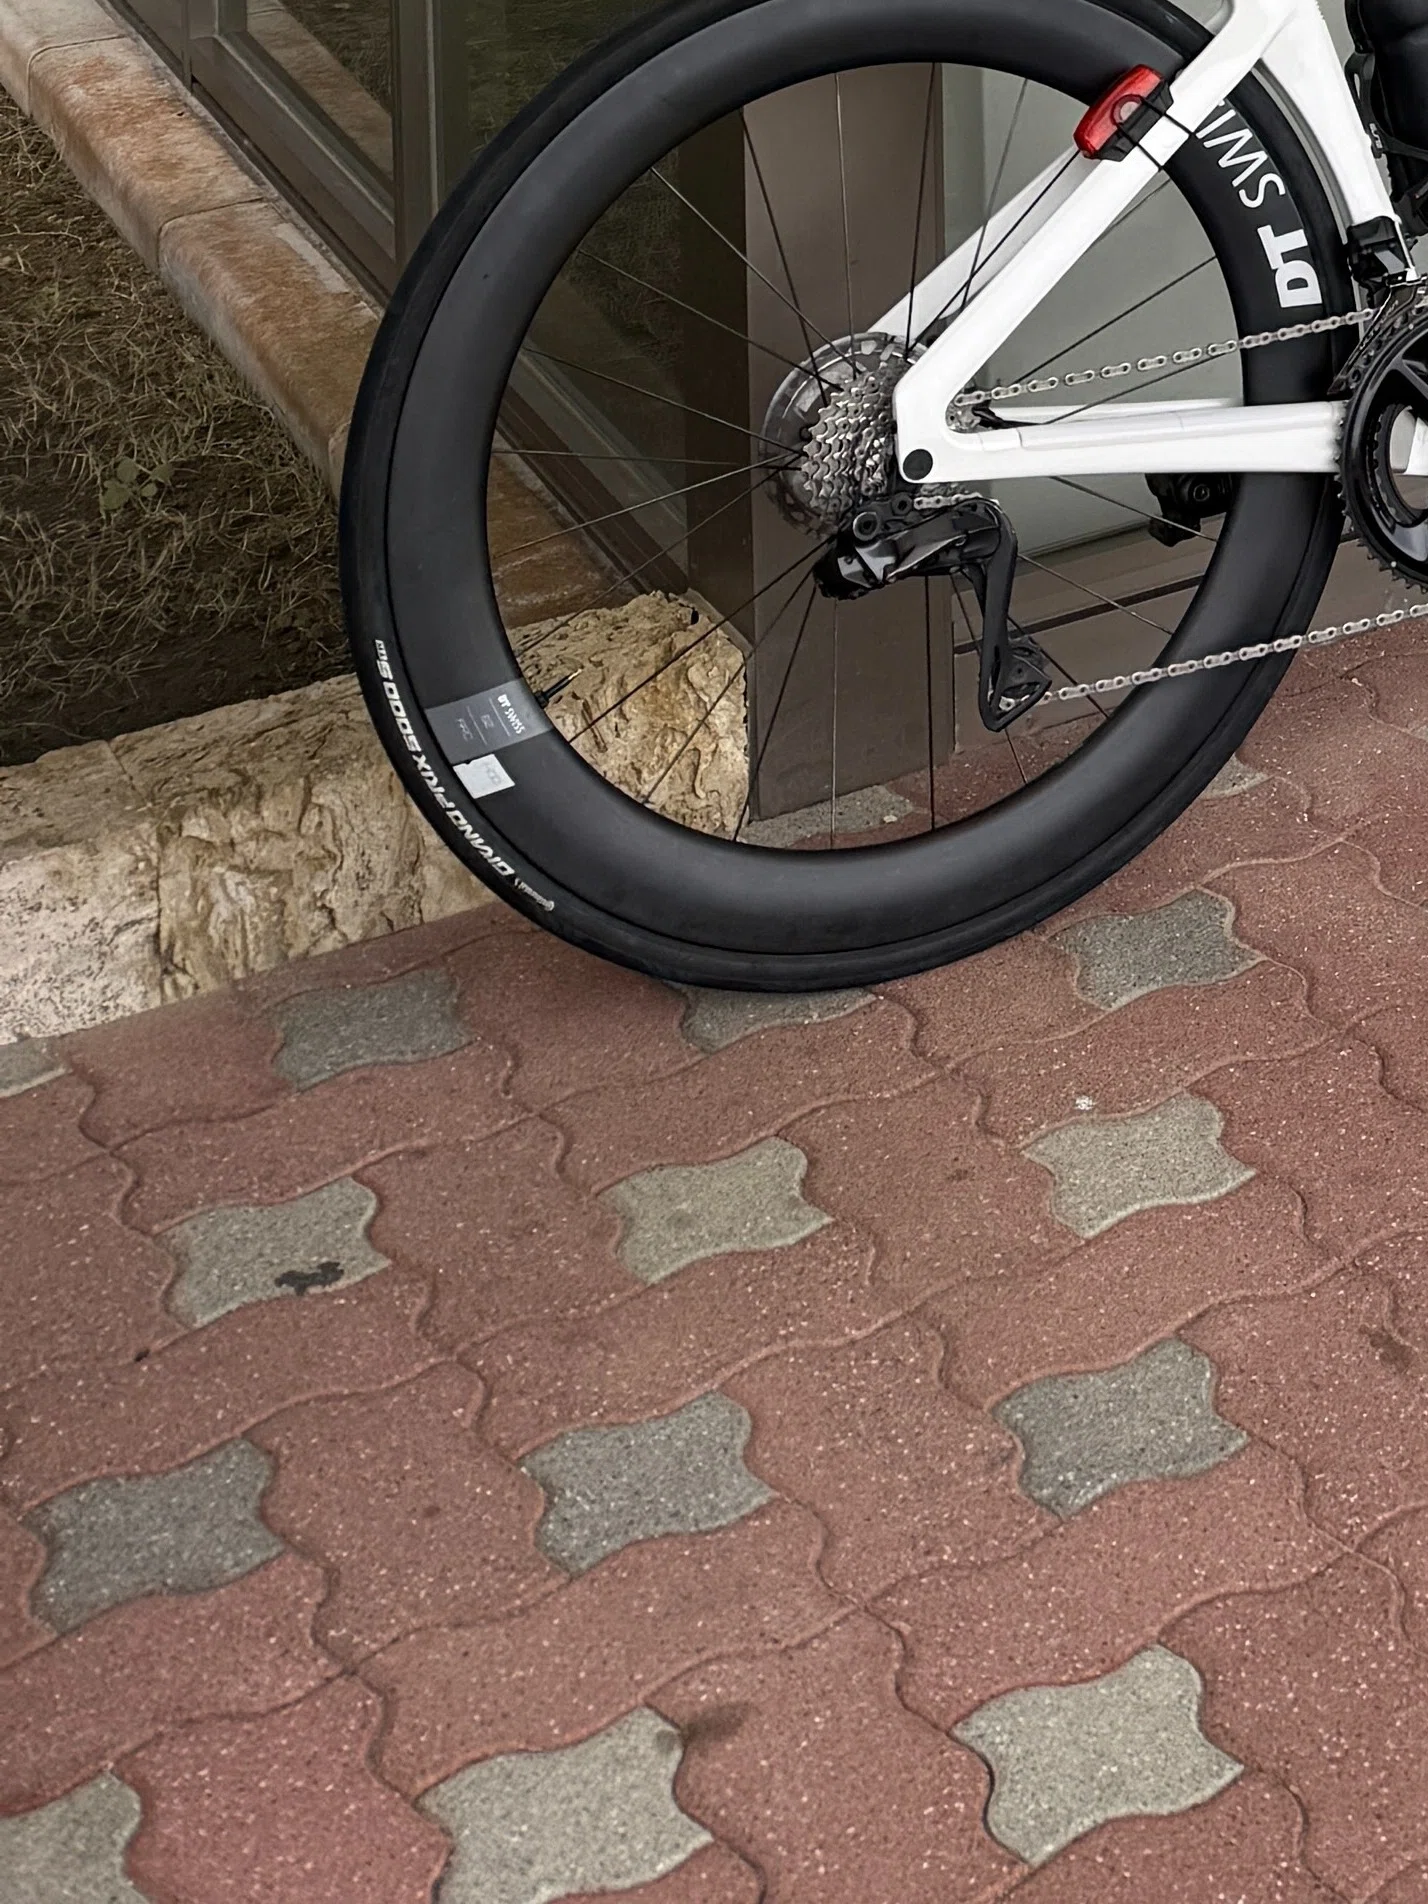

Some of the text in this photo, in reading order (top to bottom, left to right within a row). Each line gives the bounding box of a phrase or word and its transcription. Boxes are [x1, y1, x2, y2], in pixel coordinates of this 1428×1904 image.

[1195, 98, 1323, 309] DT SWI
[382, 680, 423, 753] 5000
[411, 753, 456, 810] PRIX
[446, 808, 516, 876] GRAND
